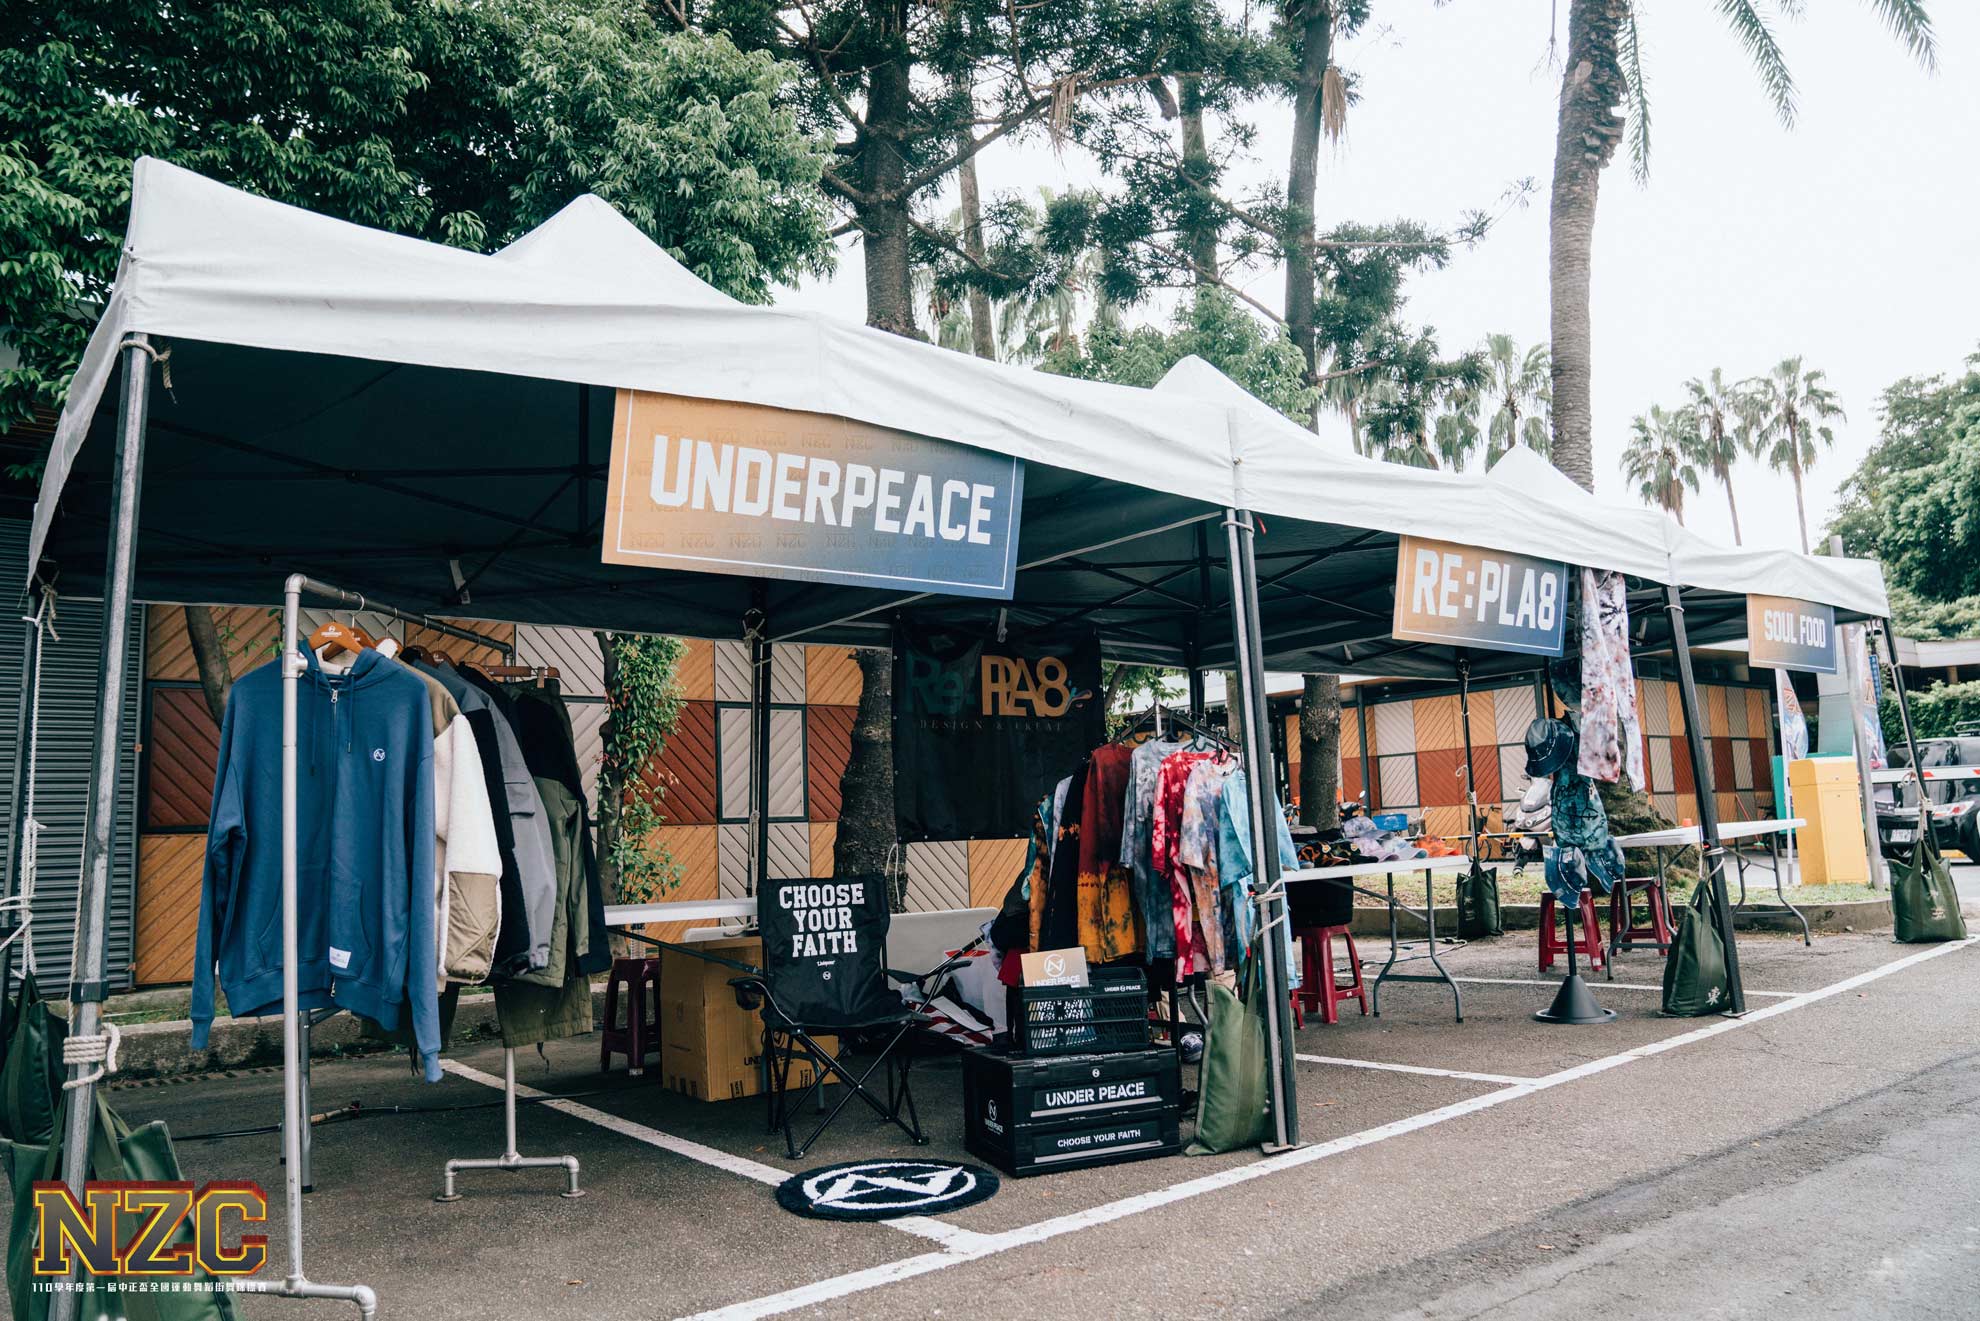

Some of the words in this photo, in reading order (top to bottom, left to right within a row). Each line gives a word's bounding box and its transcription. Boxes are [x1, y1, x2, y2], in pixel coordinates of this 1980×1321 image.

[650, 435, 995, 545] UNDERPEACE
[1412, 548, 1557, 631] RE:PLA8
[1764, 608, 1797, 644] SOUL
[1800, 614, 1826, 648] FOOD
[779, 883, 865, 909] CHOOSE
[793, 907, 853, 932] YOUR
[792, 930, 858, 957] FAITH
[1045, 1088, 1095, 1107] UNDER
[1098, 1081, 1145, 1101] PEACE
[1057, 1136, 1091, 1148] CHOOSE
[1093, 1132, 1116, 1143] YOUR
[1117, 1128, 1141, 1140] FAITH
